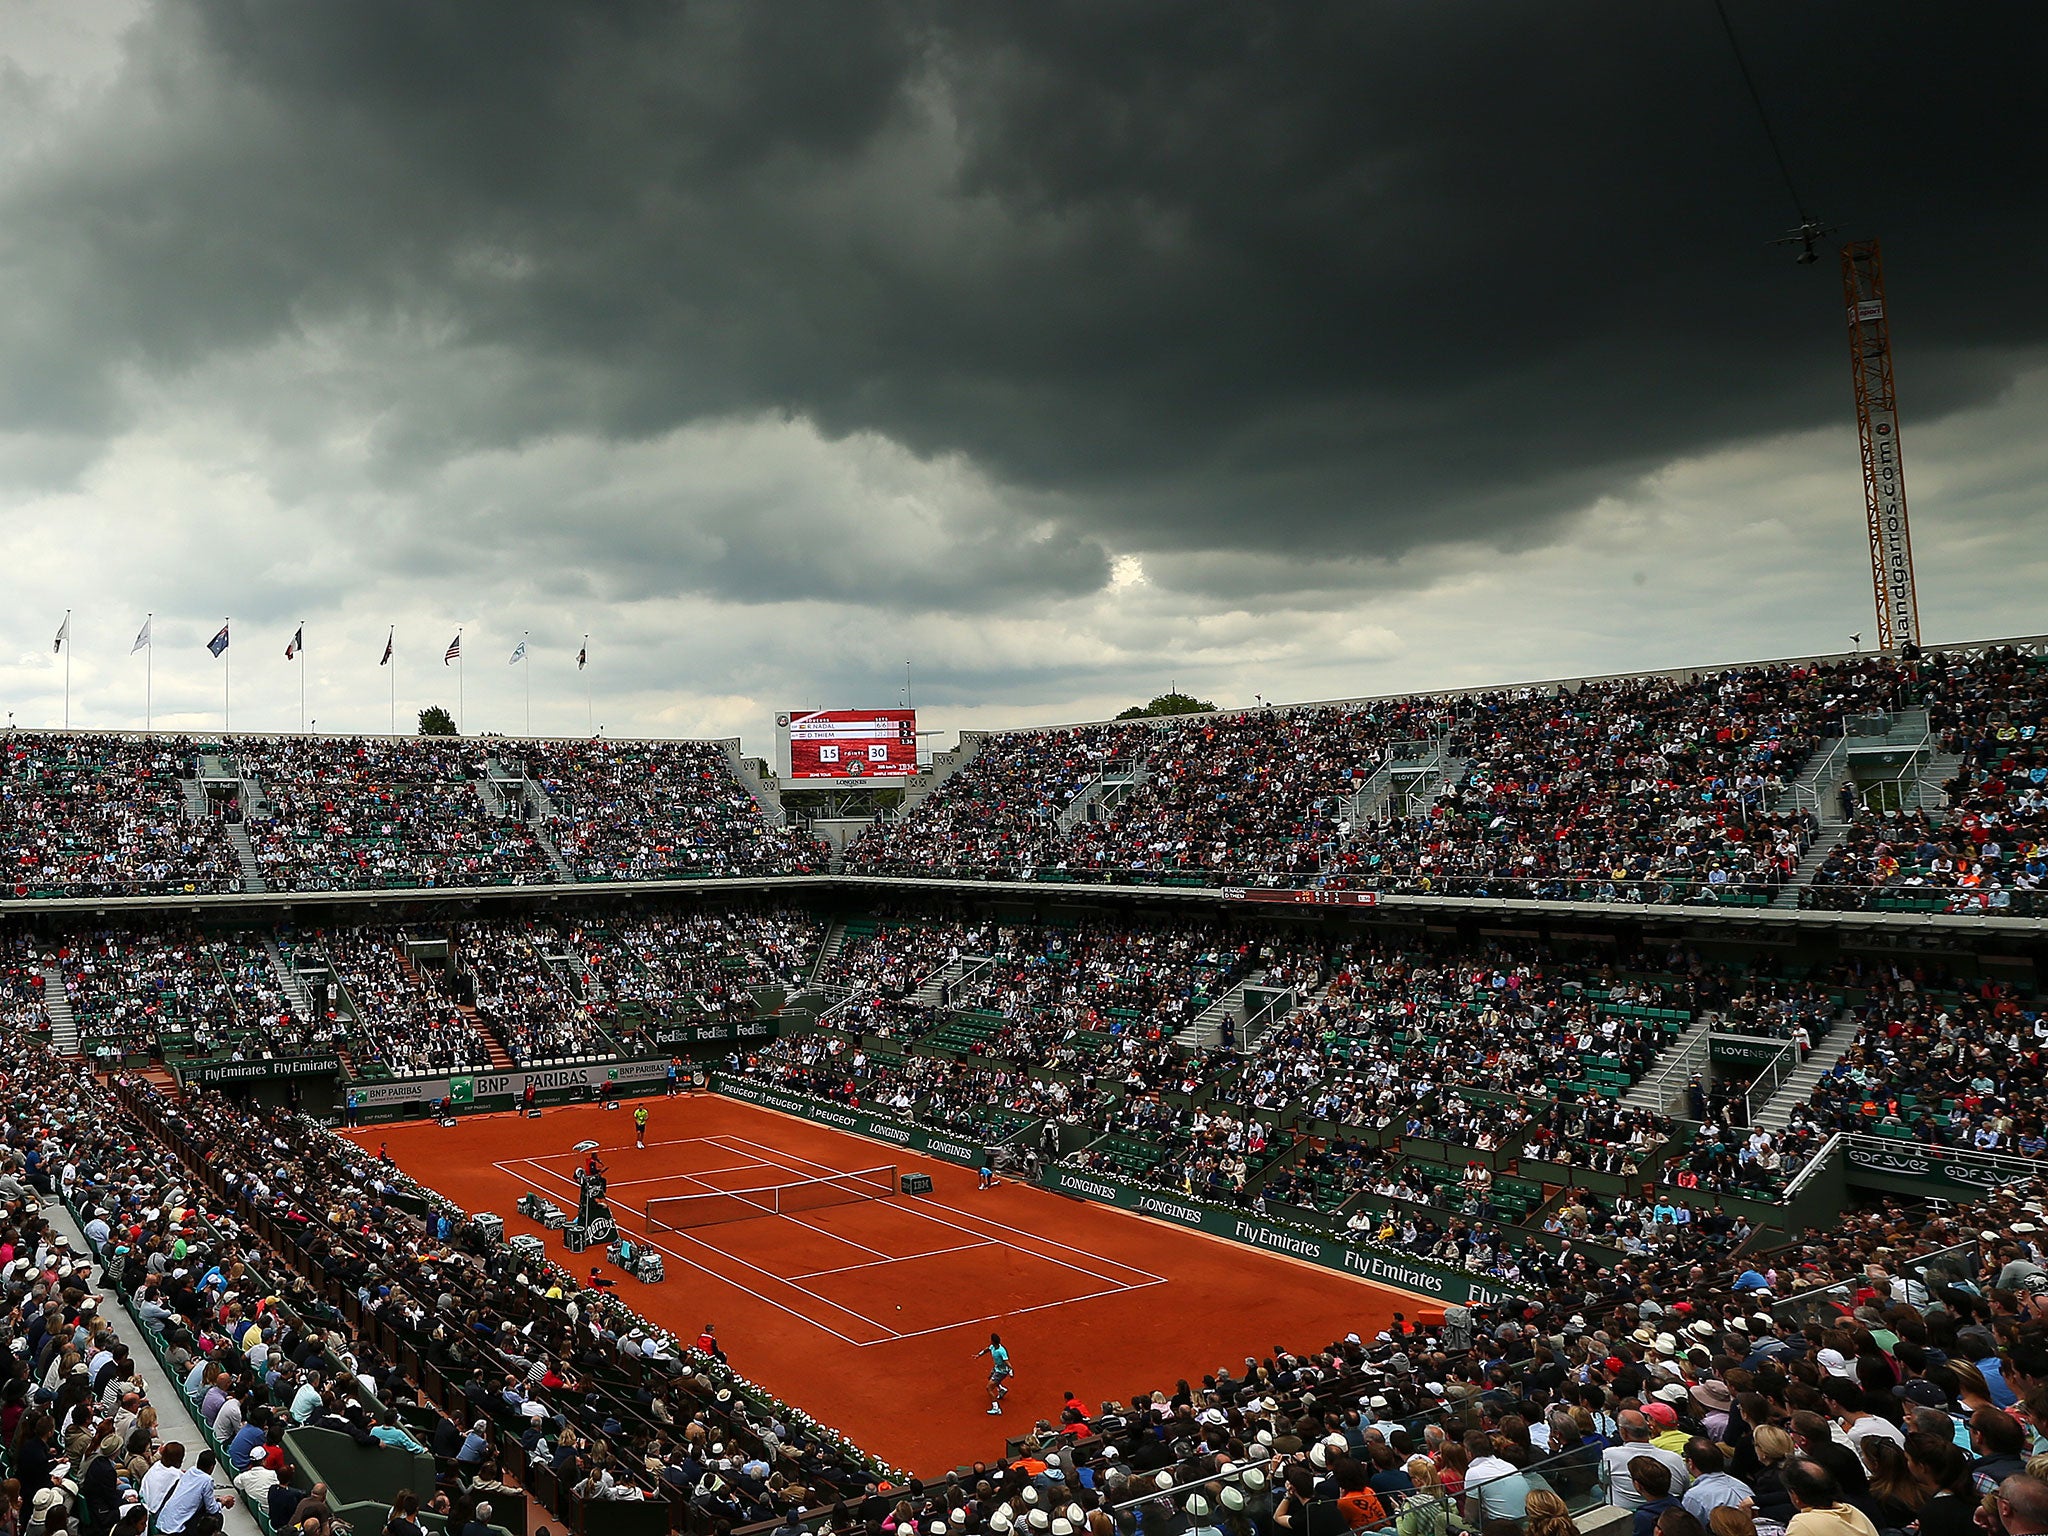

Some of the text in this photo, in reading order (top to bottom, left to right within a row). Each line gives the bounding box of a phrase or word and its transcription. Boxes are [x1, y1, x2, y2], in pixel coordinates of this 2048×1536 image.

[823, 749, 837, 758] 15
[871, 748, 885, 757] 30
[899, 763, 915, 771] IBM
[656, 1030, 688, 1043] FedEx
[697, 1026, 728, 1040] FedEx
[737, 1022, 767, 1036] FedEx
[185, 1069, 202, 1080] IBM
[205, 1065, 267, 1082] Fly Emirates
[273, 1060, 338, 1075] Fly Emirates
[620, 1064, 665, 1075] BNP PARIBAS
[477, 1070, 588, 1094] BNP PARIBAS
[370, 1085, 422, 1098] BNP PARIBAS
[724, 1084, 759, 1100] PEUGEOT
[766, 1095, 804, 1112] PEUGEOT
[815, 1109, 857, 1127] PEUGEOT
[869, 1122, 911, 1142] LONGINES
[926, 1138, 973, 1160] LONGINES
[1848, 1150, 1882, 1163] GDF
[1944, 1165, 1980, 1178] GDF
[913, 1179, 929, 1190] IBM
[1060, 1174, 1117, 1201] LONGINES
[1138, 1196, 1203, 1224] LONGINES
[585, 1218, 617, 1244] Perrier
[1235, 1221, 1322, 1259] Fly Emirates
[1344, 1250, 1444, 1293] Fly Emirates
[1468, 1283, 1499, 1304] Fly
